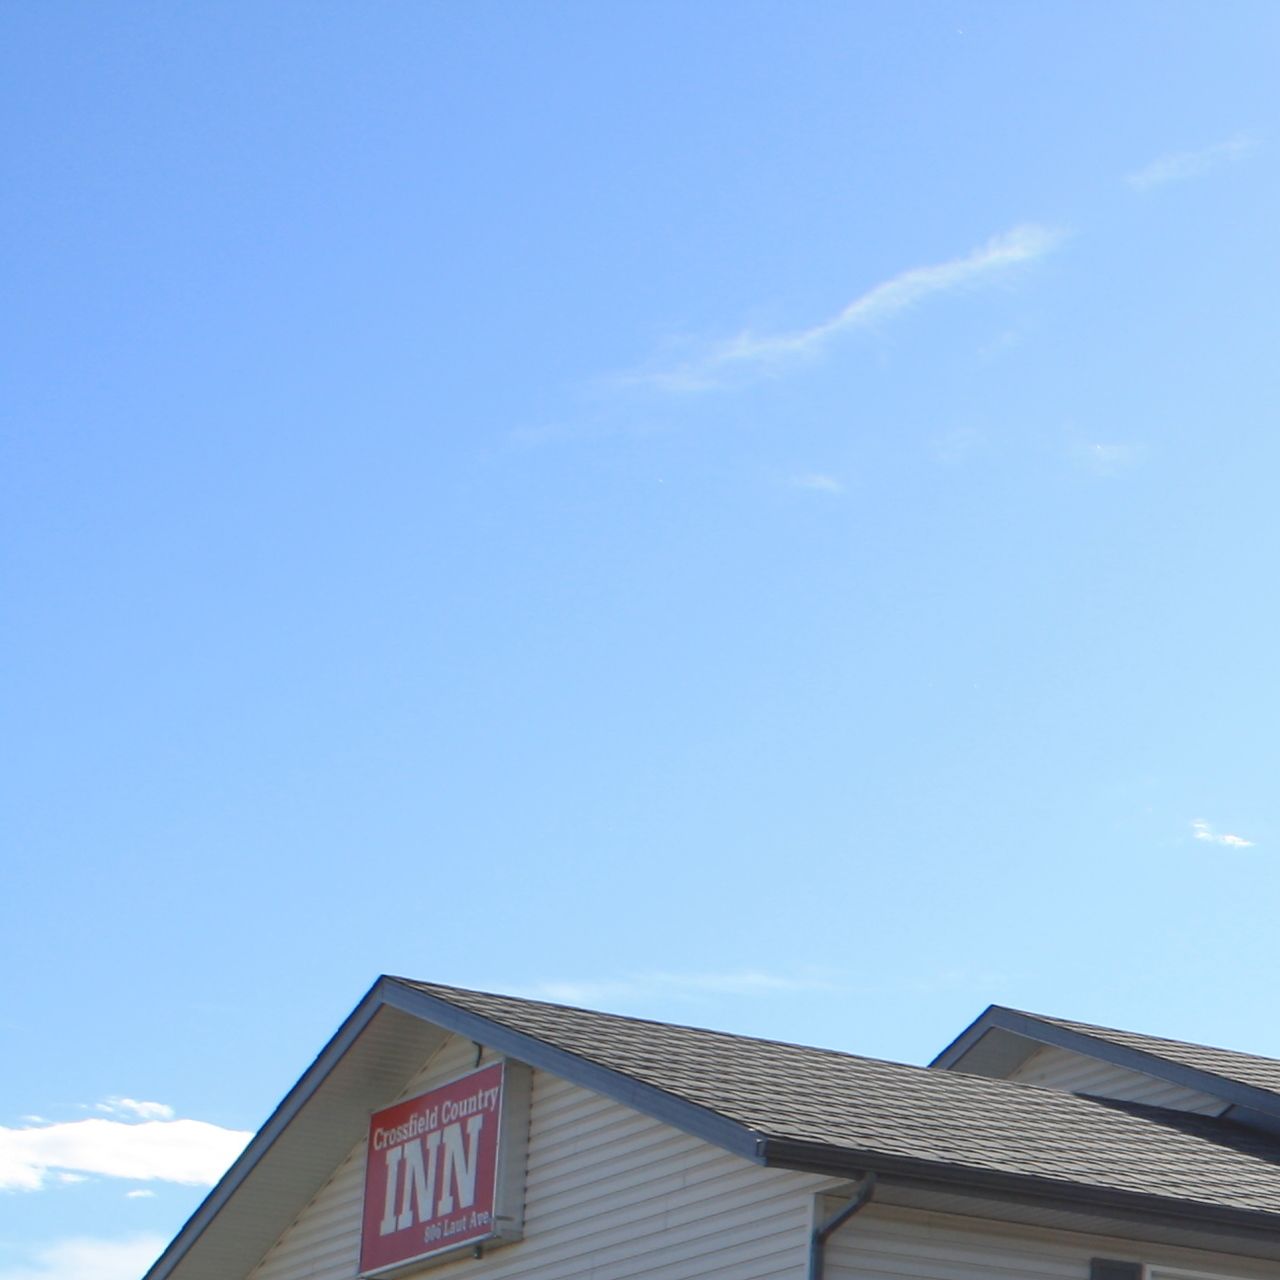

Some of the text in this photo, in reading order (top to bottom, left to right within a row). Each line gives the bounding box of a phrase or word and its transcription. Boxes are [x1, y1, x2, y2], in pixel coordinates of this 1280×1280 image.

[373, 1086, 499, 1151] Crossfield Country
[379, 1113, 484, 1236] INN
